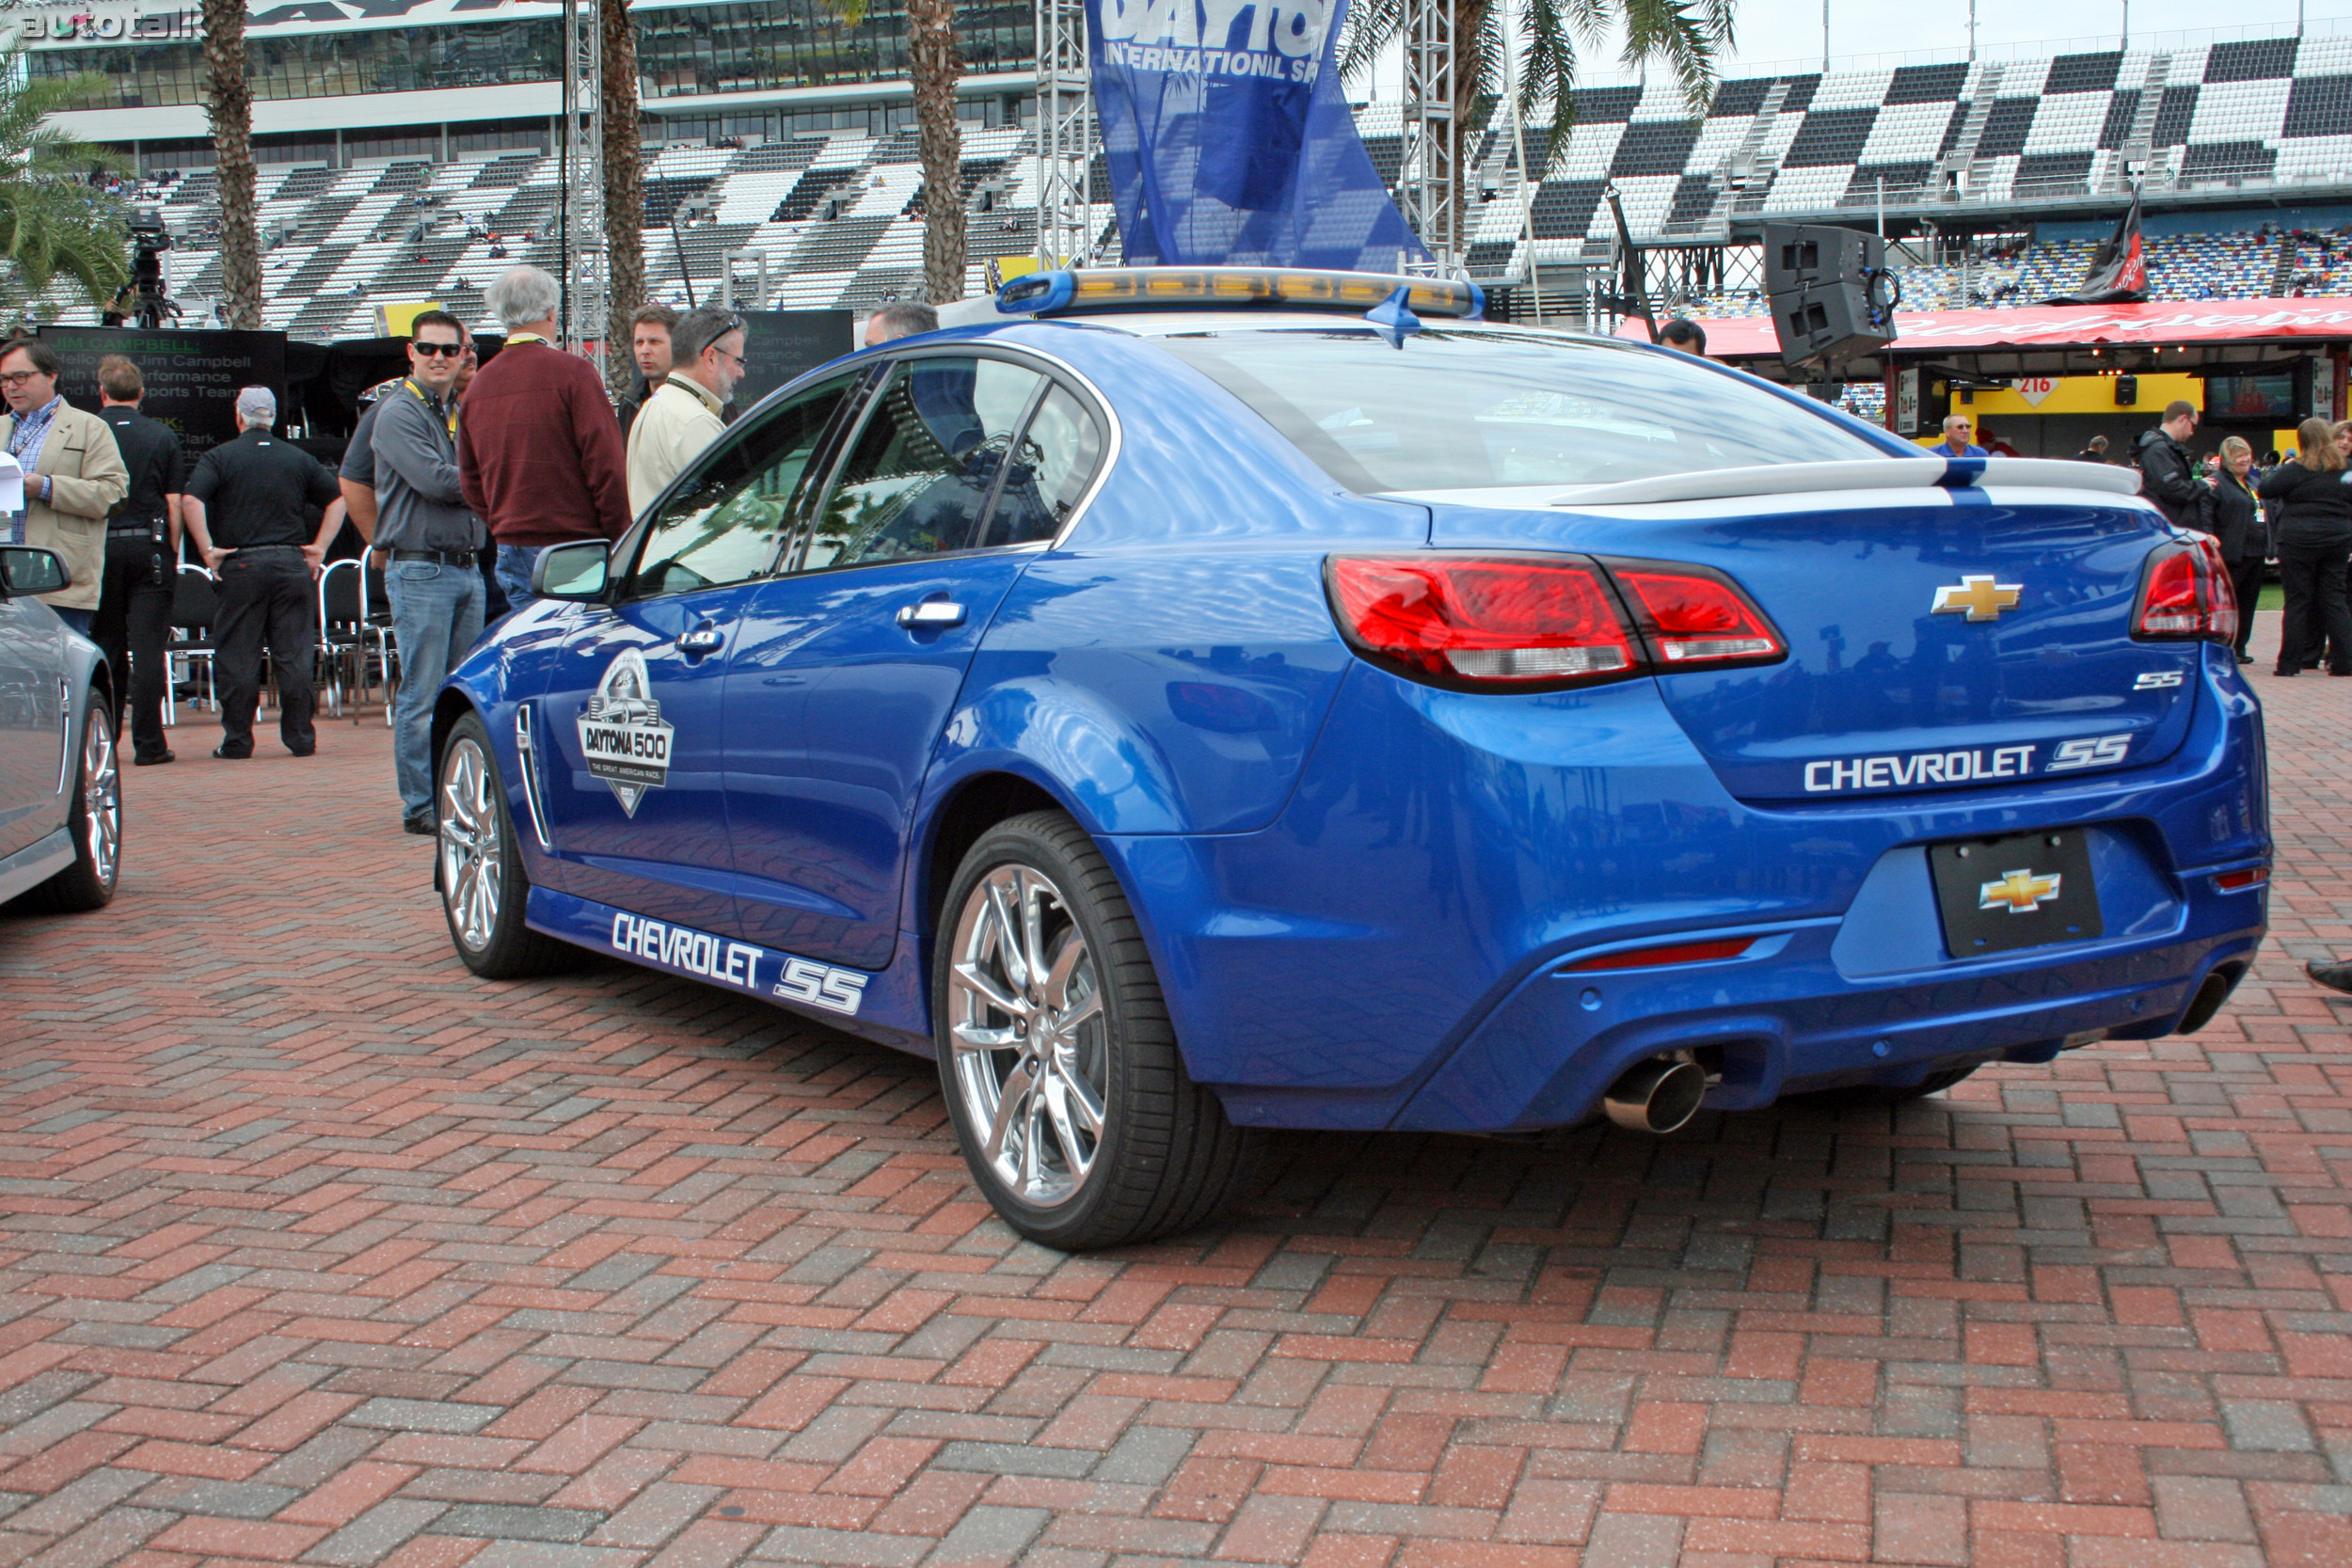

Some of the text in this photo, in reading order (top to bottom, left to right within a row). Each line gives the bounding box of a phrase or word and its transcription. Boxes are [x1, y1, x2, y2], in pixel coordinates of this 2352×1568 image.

[52, 338, 83, 349] JIM
[137, 355, 167, 367] Jim
[172, 355, 251, 368] Campbell
[141, 370, 231, 382] erformance
[2019, 377, 2051, 392] 216
[2133, 670, 2184, 690] SS
[586, 727, 666, 760] DAYTONA 500
[592, 763, 601, 771] THE
[602, 765, 617, 773] GREAT
[619, 767, 644, 777] AMERICAN
[1804, 734, 2134, 792] CHEVROLET SS
[612, 912, 868, 1016] CHEVROLET SS
